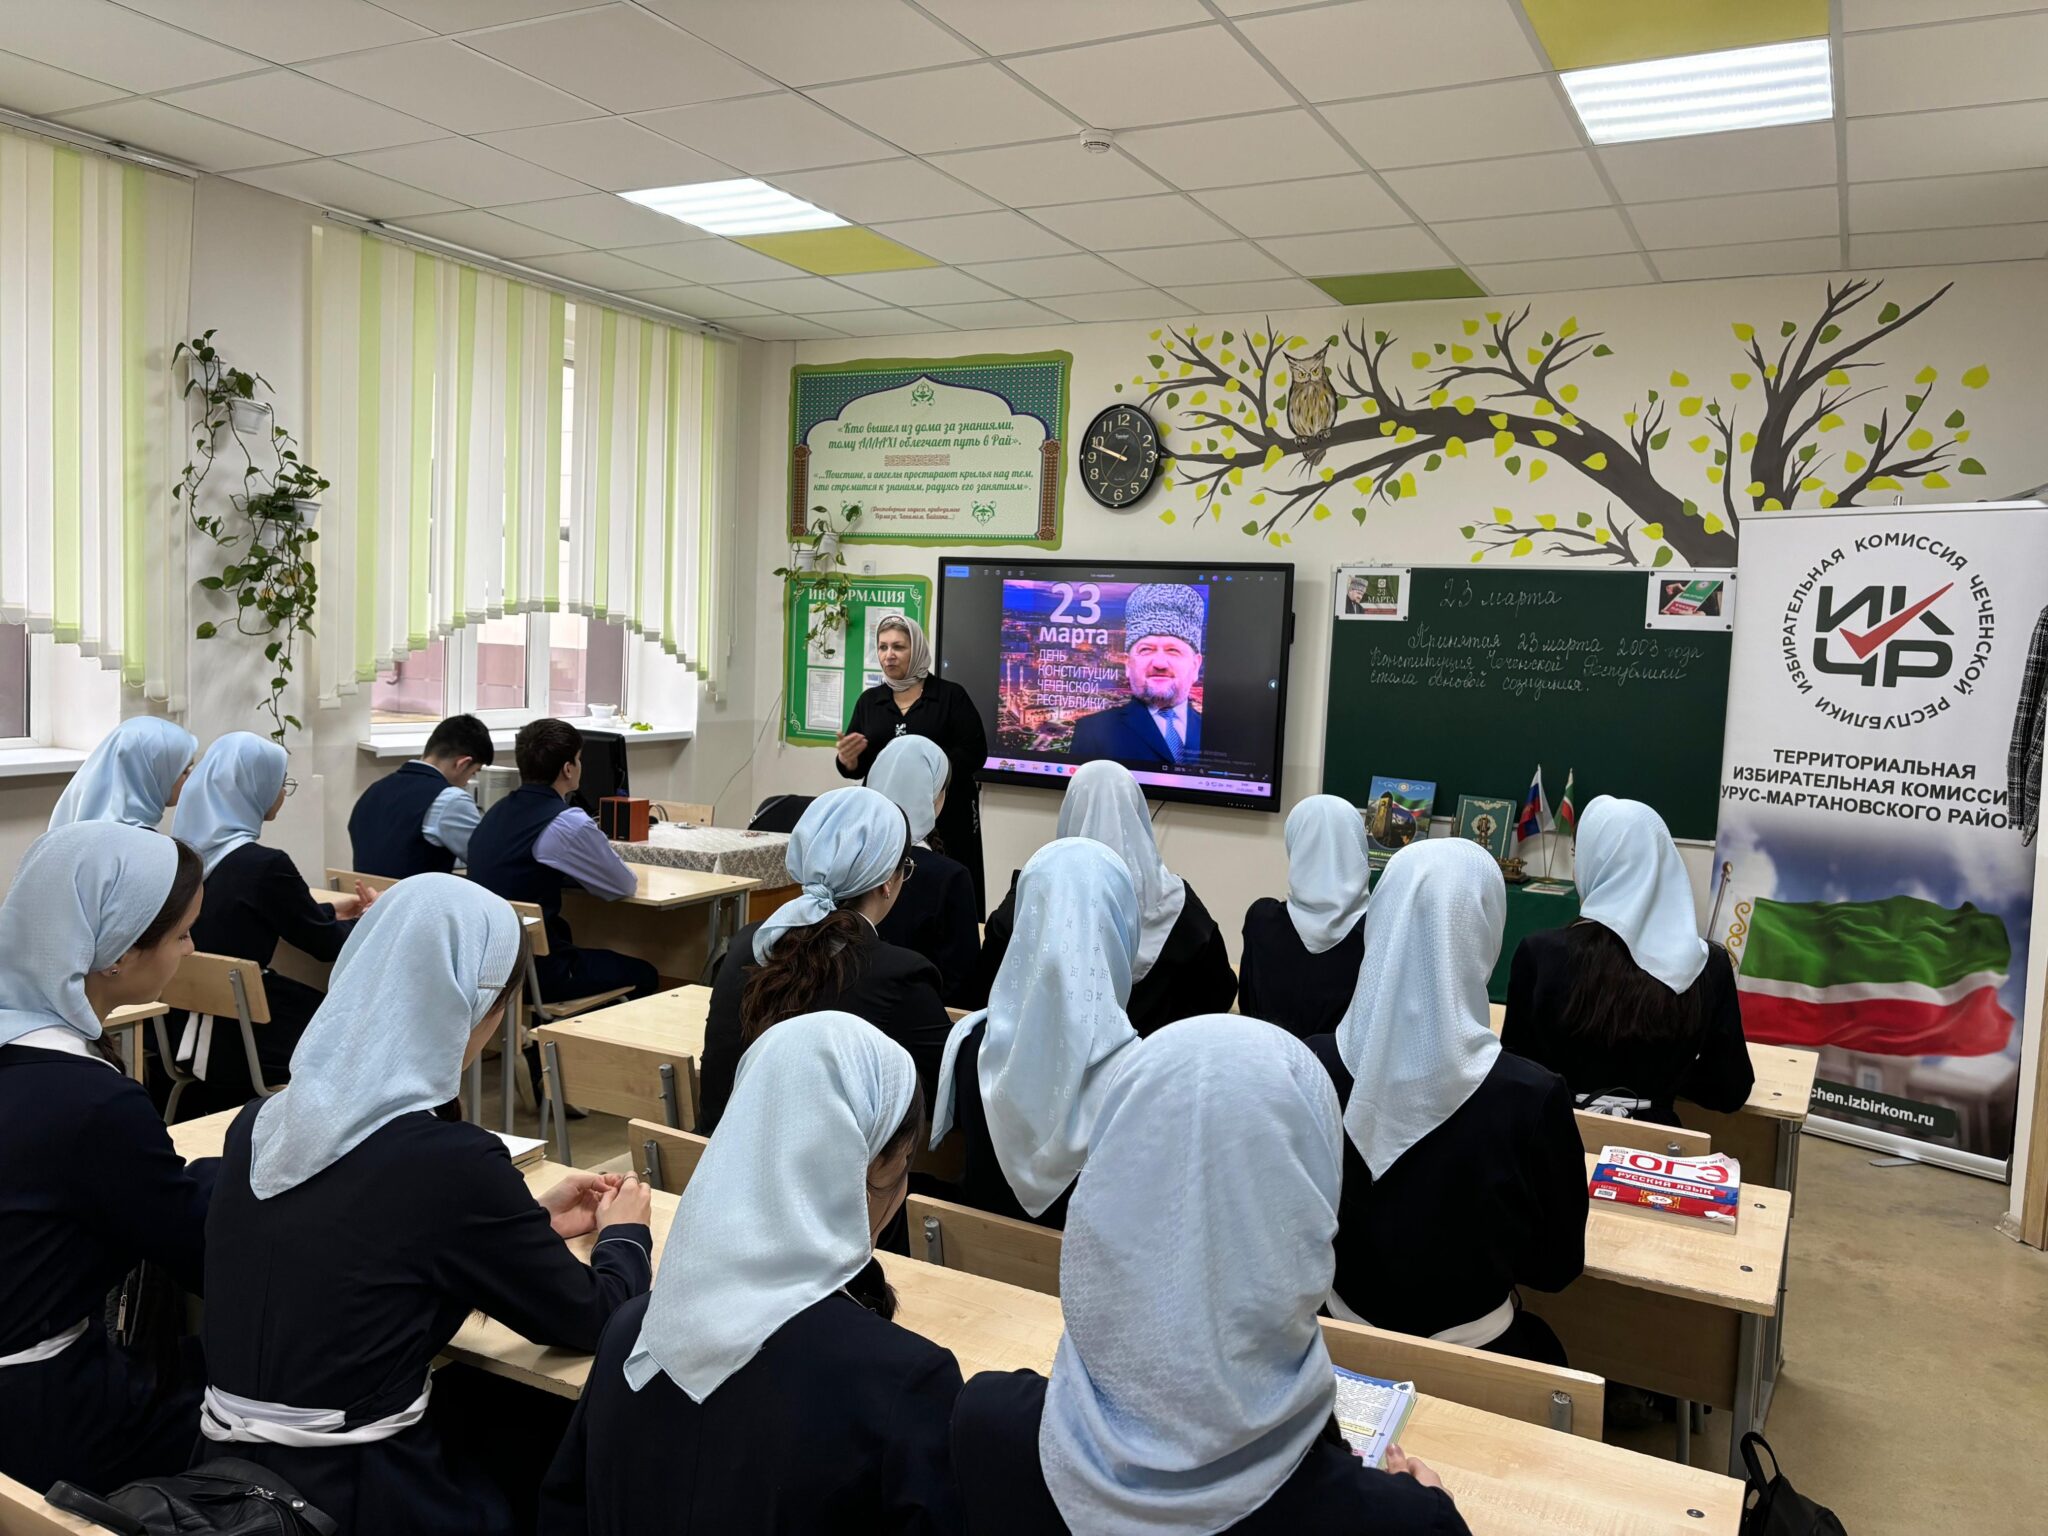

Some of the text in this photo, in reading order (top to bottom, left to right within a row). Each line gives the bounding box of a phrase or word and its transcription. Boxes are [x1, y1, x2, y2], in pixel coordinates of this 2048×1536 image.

[1102, 420, 1112, 433] 11
[1117, 413, 1130, 426] 12
[1136, 421, 1141, 433] 1
[866, 422, 899, 433] вышел
[901, 424, 913, 436] из
[915, 423, 942, 435] дома
[943, 422, 956, 435] за
[957, 421, 1014, 435] знаниями,
[828, 440, 856, 452] тому
[899, 436, 951, 448] облегчает
[953, 438, 980, 450] путь
[983, 434, 989, 446] в
[1091, 436, 1104, 448] 10
[1142, 435, 1152, 447] 2
[1087, 452, 1097, 464] 9
[1146, 450, 1155, 463] 3
[873, 471, 903, 481] ангелы
[903, 470, 959, 481] простирают
[959, 470, 993, 481] крылья
[993, 470, 1009, 480] над
[1089, 468, 1099, 480] 8
[1140, 467, 1149, 480] 4
[813, 483, 830, 491] кто
[830, 483, 877, 492] стремится
[1100, 482, 1108, 494] 7
[1113, 489, 1123, 501] 6
[1130, 482, 1140, 495] 5
[808, 586, 906, 604] ИНФРМАЦИЯ
[1376, 588, 1386, 596] 23
[1439, 577, 1563, 617] 23 марта
[1049, 582, 1101, 625] 23
[1367, 596, 1395, 604] МАРТА
[1038, 626, 1109, 649] марта
[1782, 531, 1995, 730] ИЗБИРАТЕЛЬНАЯ КОМИССИЯ ЧЕЧЕНСКОЙ РЕСПУБЛИКИ
[1517, 631, 1539, 653] 23
[1542, 636, 1605, 660] марта
[1616, 637, 1659, 658] 2003
[1038, 648, 1067, 664] ДЕНЬ
[1369, 647, 1476, 672] Конституция
[1037, 664, 1119, 681] КОНСТИТУЦИИ
[1037, 678, 1099, 695] ЧЕЧЕНСКОЙ
[1036, 693, 1107, 710] РЕСПУБЛИКИ
[1773, 748, 1977, 780] ТЕРРИТОРИАЛЬНАЯ
[1732, 766, 2009, 806] ИЗБИРАТЕЛЬНАЯ КОМИССИ
[1721, 784, 2023, 831] УРУС-МАРТАНОВСКОГО РАЙО
[1628, 1154, 1729, 1184] ОГЭ
[1617, 1171, 1672, 1188] РУССКИЙ
[1676, 1182, 1713, 1196] ЯЗЫК
